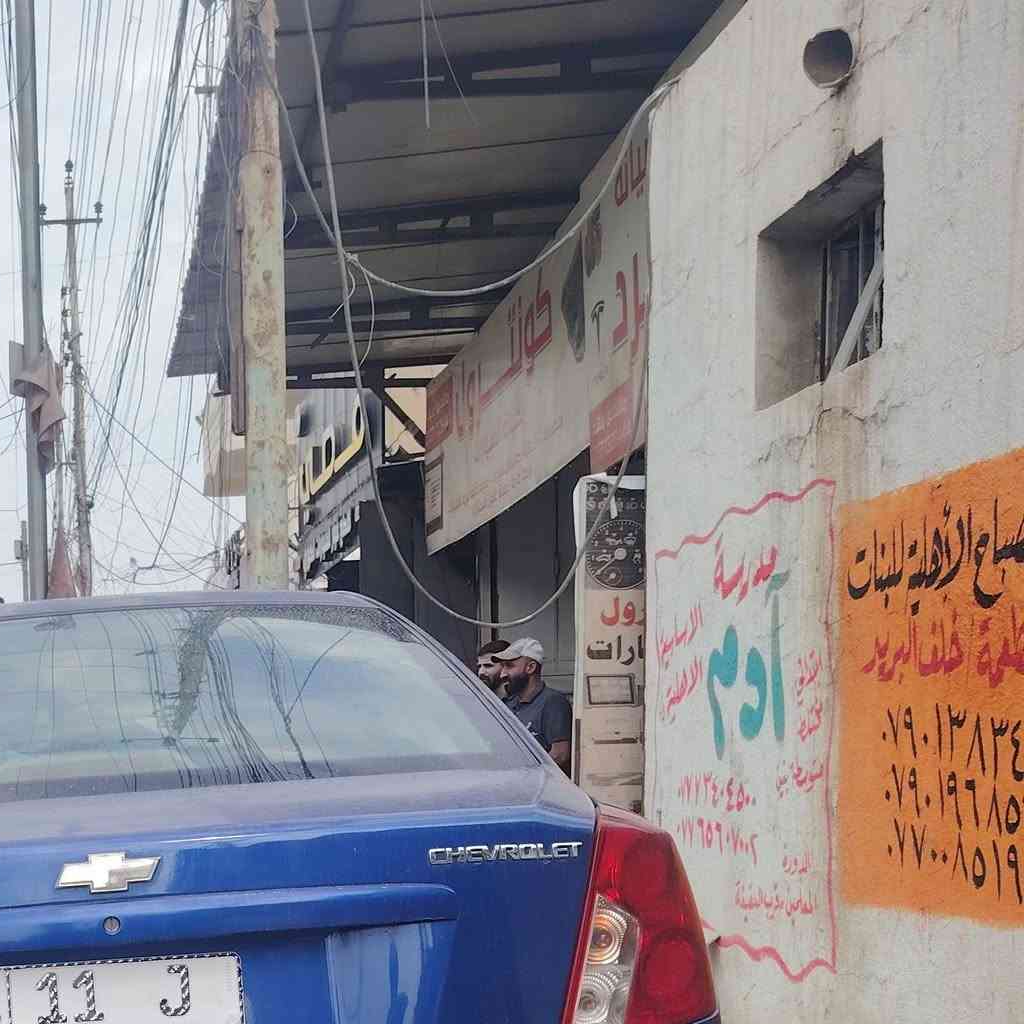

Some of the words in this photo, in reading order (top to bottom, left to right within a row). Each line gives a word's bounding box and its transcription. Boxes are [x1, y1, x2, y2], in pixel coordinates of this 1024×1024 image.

[848, 519, 905, 609] للبنات
[587, 634, 645, 666] ارات
[707, 569, 791, 761] آدم
[885, 763, 1024, 837] ٠٧٩٠١٩٦٨٥
[428, 842, 583, 865] CHEVROLET
[36, 970, 105, 1024] 11
[160, 964, 192, 1017] J
